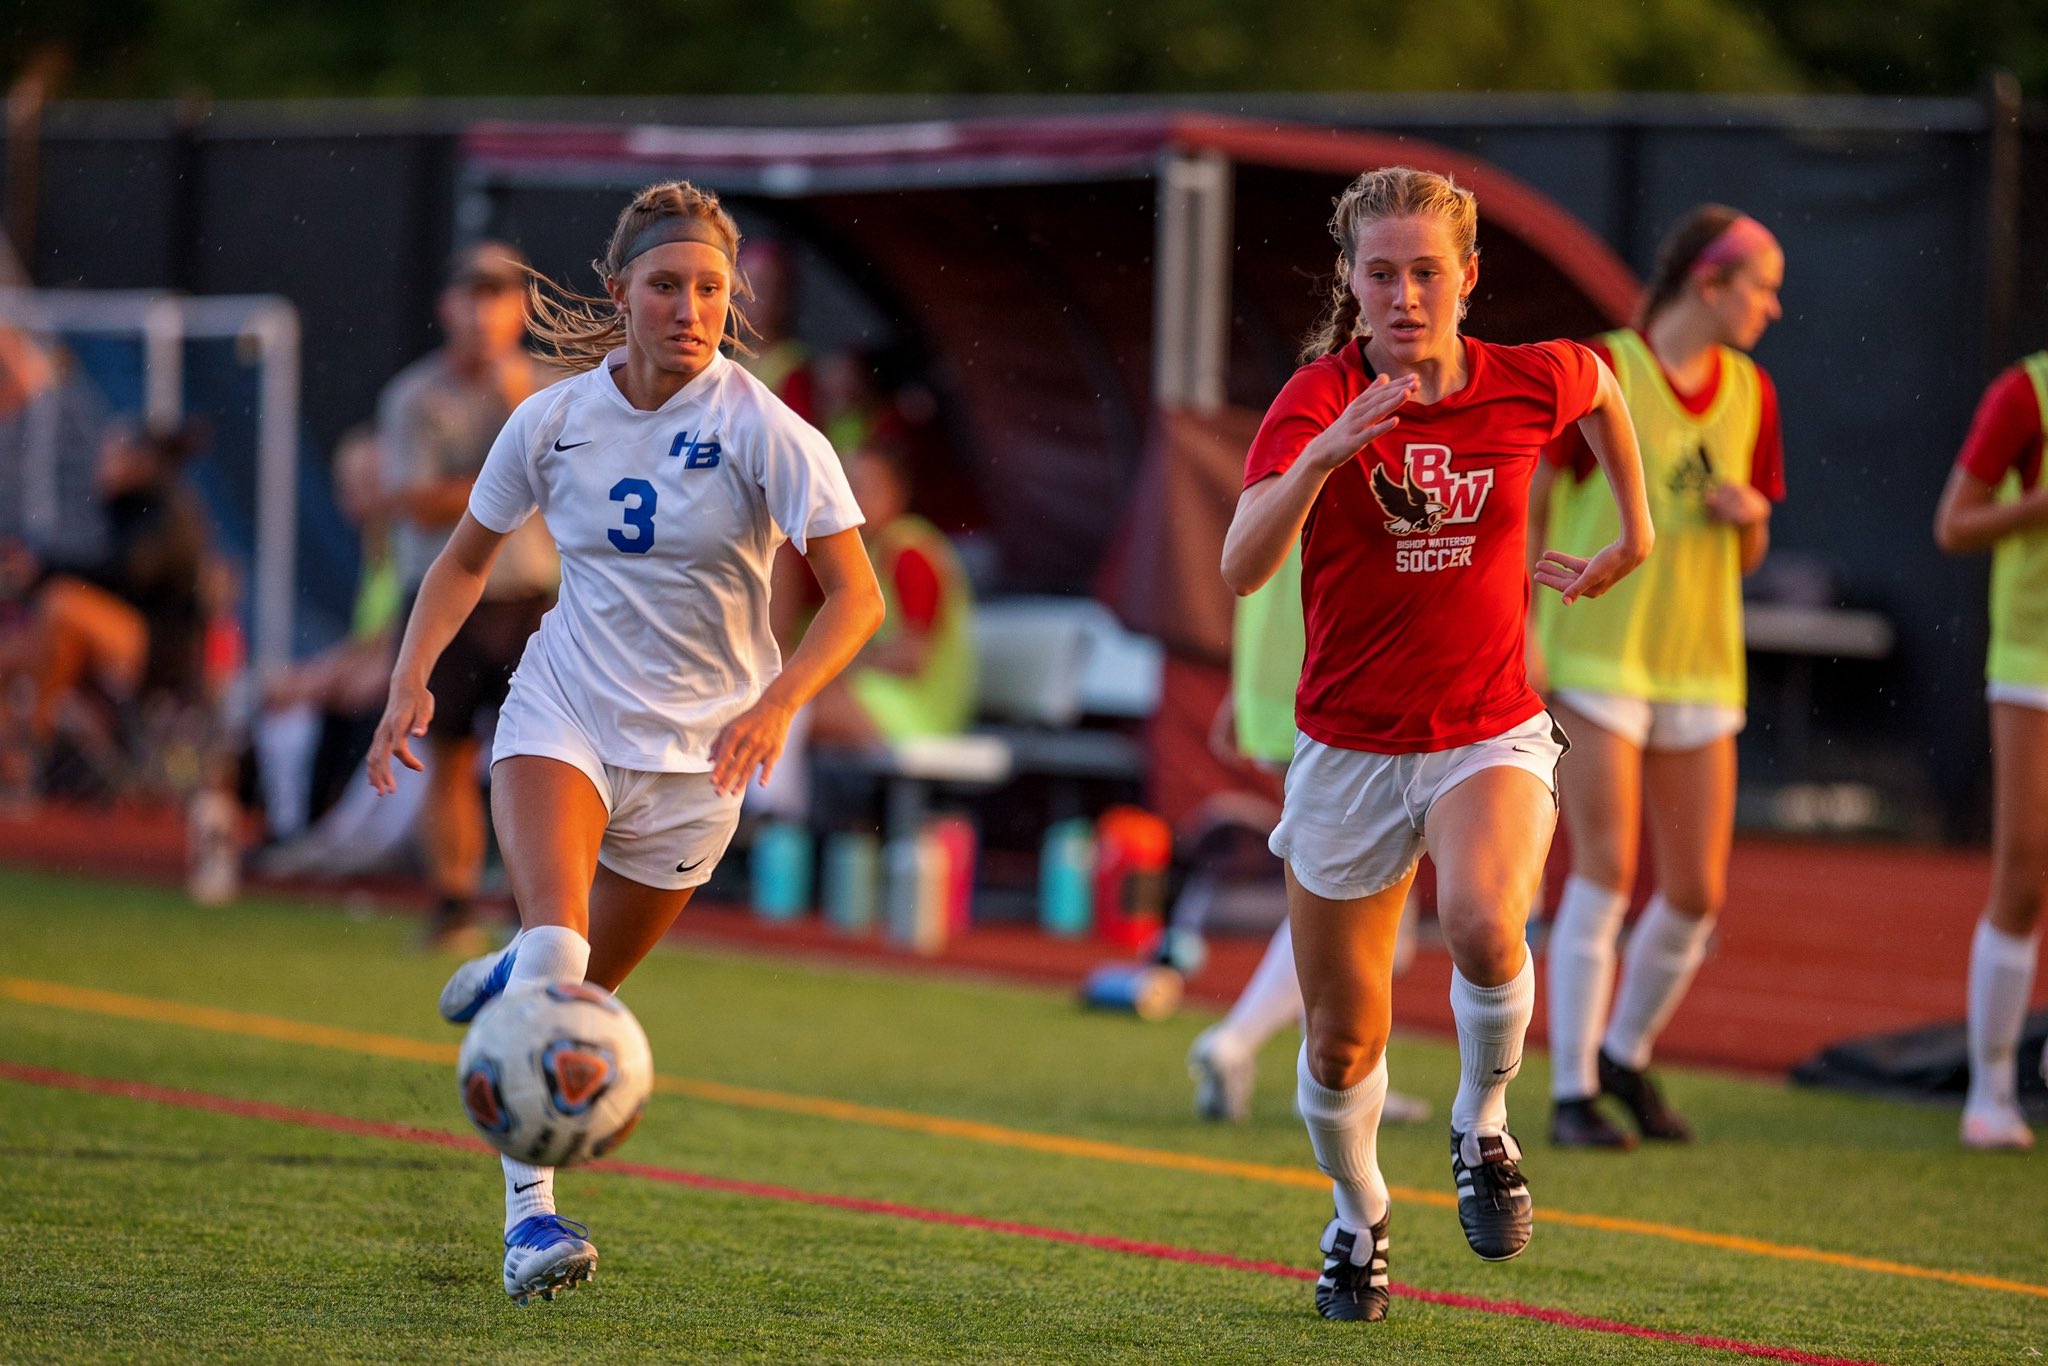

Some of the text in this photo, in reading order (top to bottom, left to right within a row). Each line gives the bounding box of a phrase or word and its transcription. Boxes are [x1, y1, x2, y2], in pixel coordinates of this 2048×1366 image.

[669, 430, 722, 469] HB
[607, 477, 658, 554] 3
[1396, 535, 1477, 549] BISHOP WATTERSON
[1395, 545, 1473, 573] SOCCER
